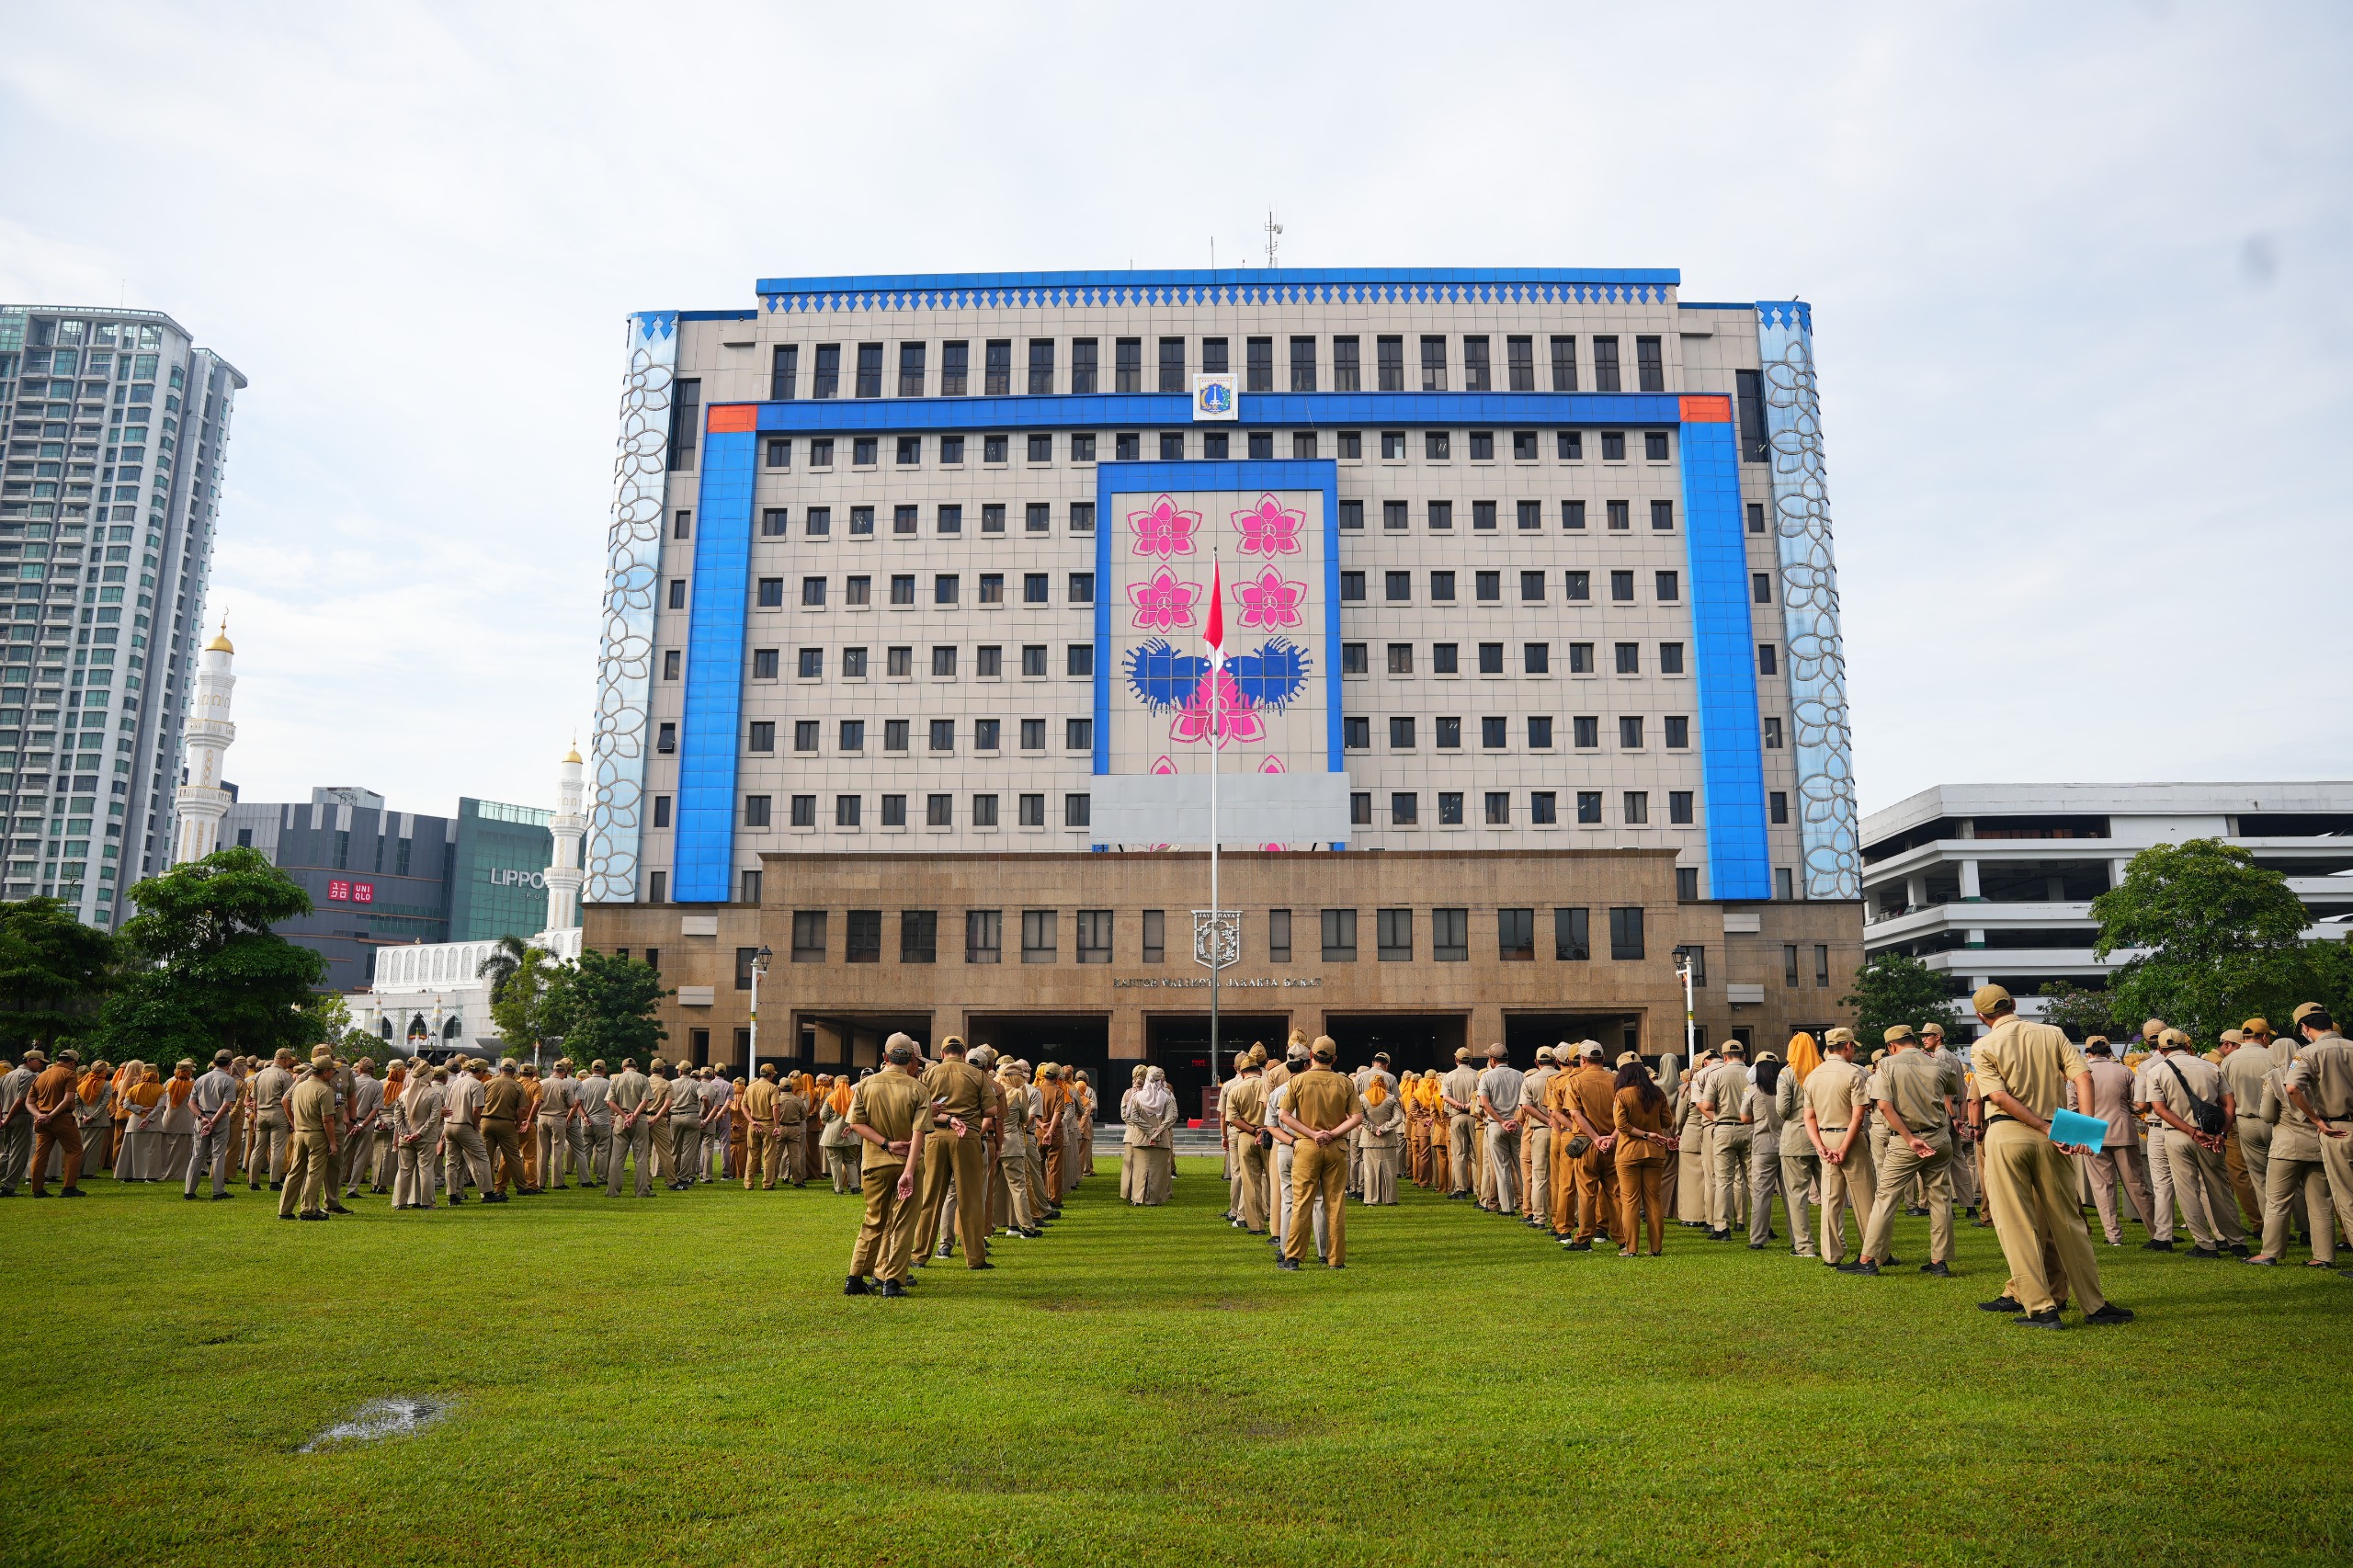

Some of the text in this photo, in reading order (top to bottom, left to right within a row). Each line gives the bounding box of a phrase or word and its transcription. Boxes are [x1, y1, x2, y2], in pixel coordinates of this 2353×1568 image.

[490, 867, 545, 890] LIPPO
[356, 884, 370, 893] UNI
[355, 892, 370, 901] QLO
[1113, 978, 1158, 988] KANTOR
[1225, 978, 1279, 988] JAKARTA
